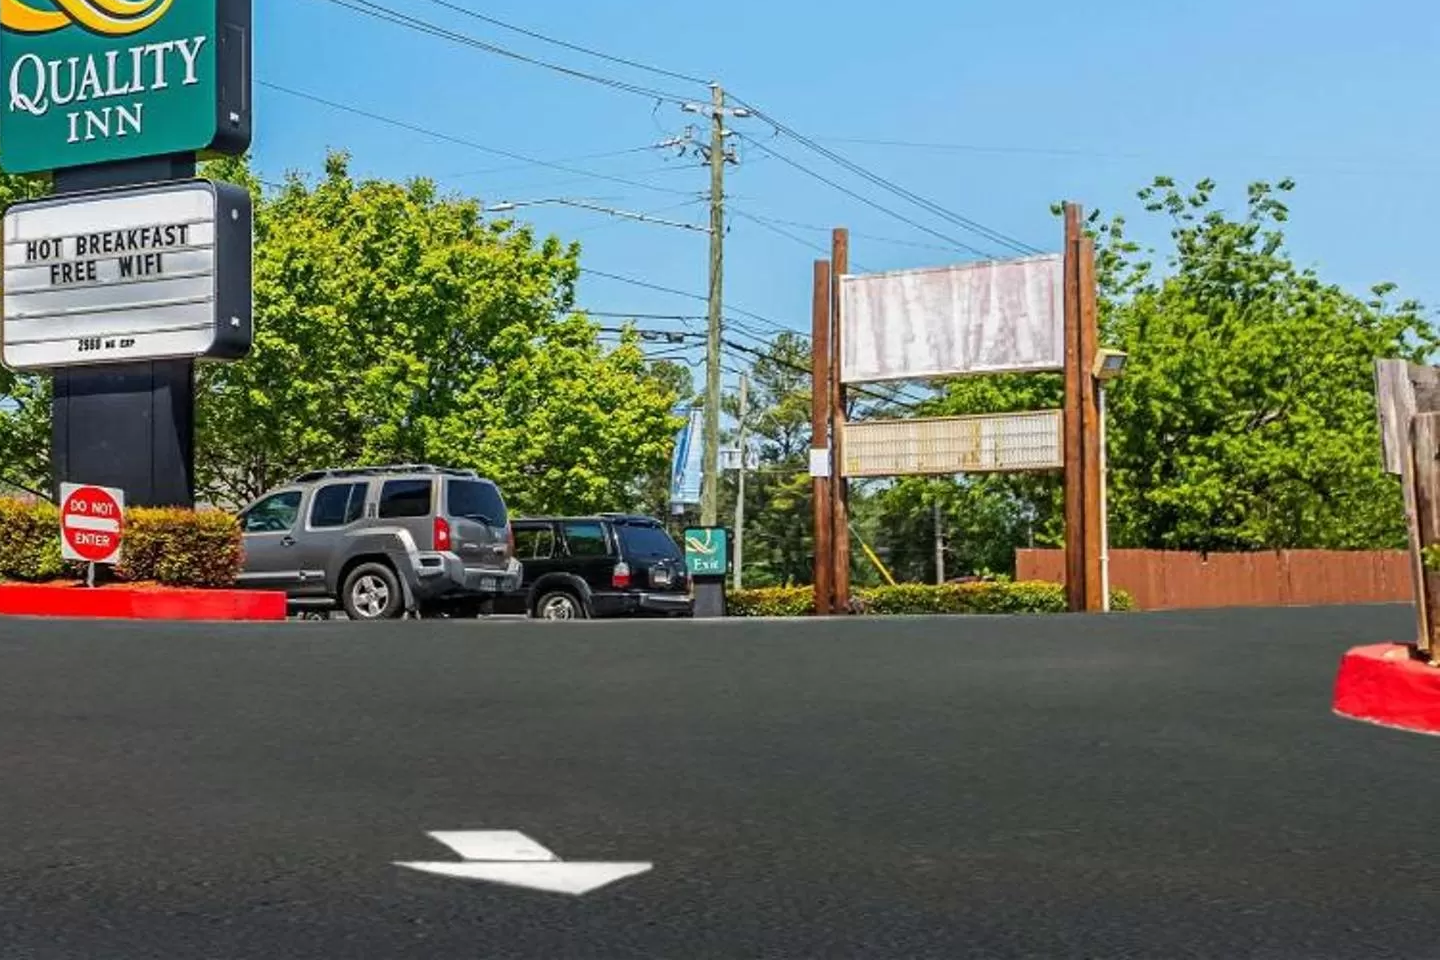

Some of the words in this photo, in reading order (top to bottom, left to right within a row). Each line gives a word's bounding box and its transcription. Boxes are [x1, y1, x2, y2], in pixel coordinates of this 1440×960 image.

[10, 36, 206, 115] QUALITY
[67, 103, 143, 143] INN
[27, 238, 62, 261] HOT
[76, 224, 188, 256] BREAKFAST
[50, 260, 97, 285] FREE
[119, 253, 163, 278] WIFI
[70, 499, 87, 513] DO
[91, 502, 114, 516] NOT
[75, 532, 110, 547] ENTER
